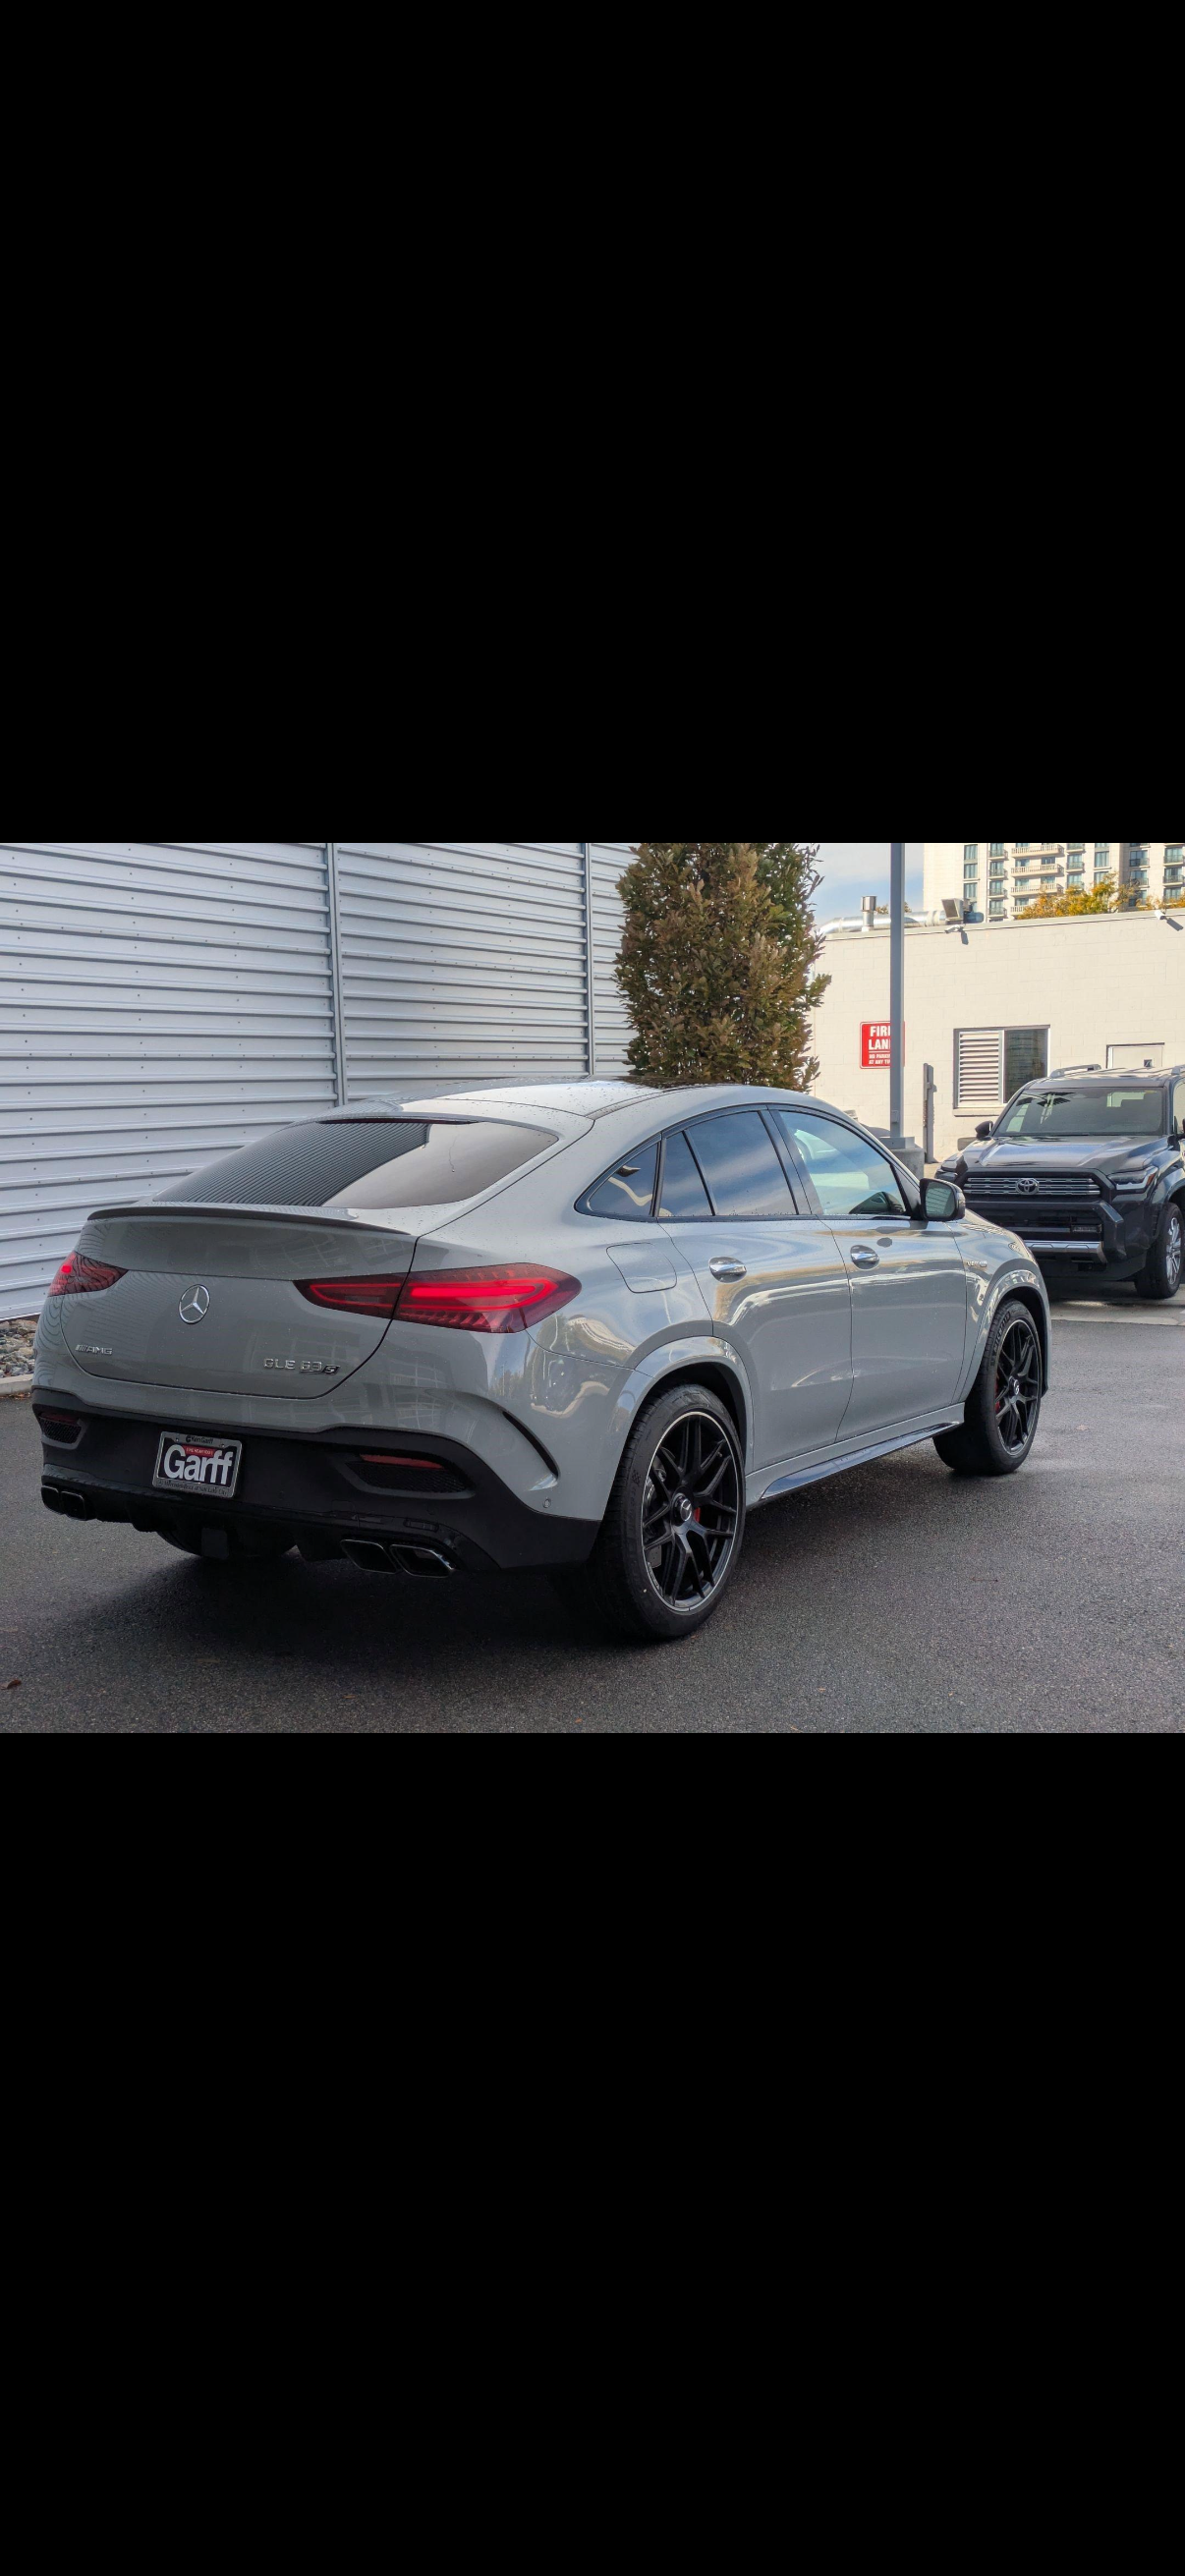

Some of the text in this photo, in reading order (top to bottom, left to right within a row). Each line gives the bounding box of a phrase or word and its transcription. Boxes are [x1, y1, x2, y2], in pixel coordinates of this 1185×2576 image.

[869, 1039, 890, 1049] LAN
[86, 1345, 113, 1355] AMG
[263, 1358, 296, 1370] GLE
[300, 1360, 322, 1372] 63
[164, 1444, 233, 1484] Garff
